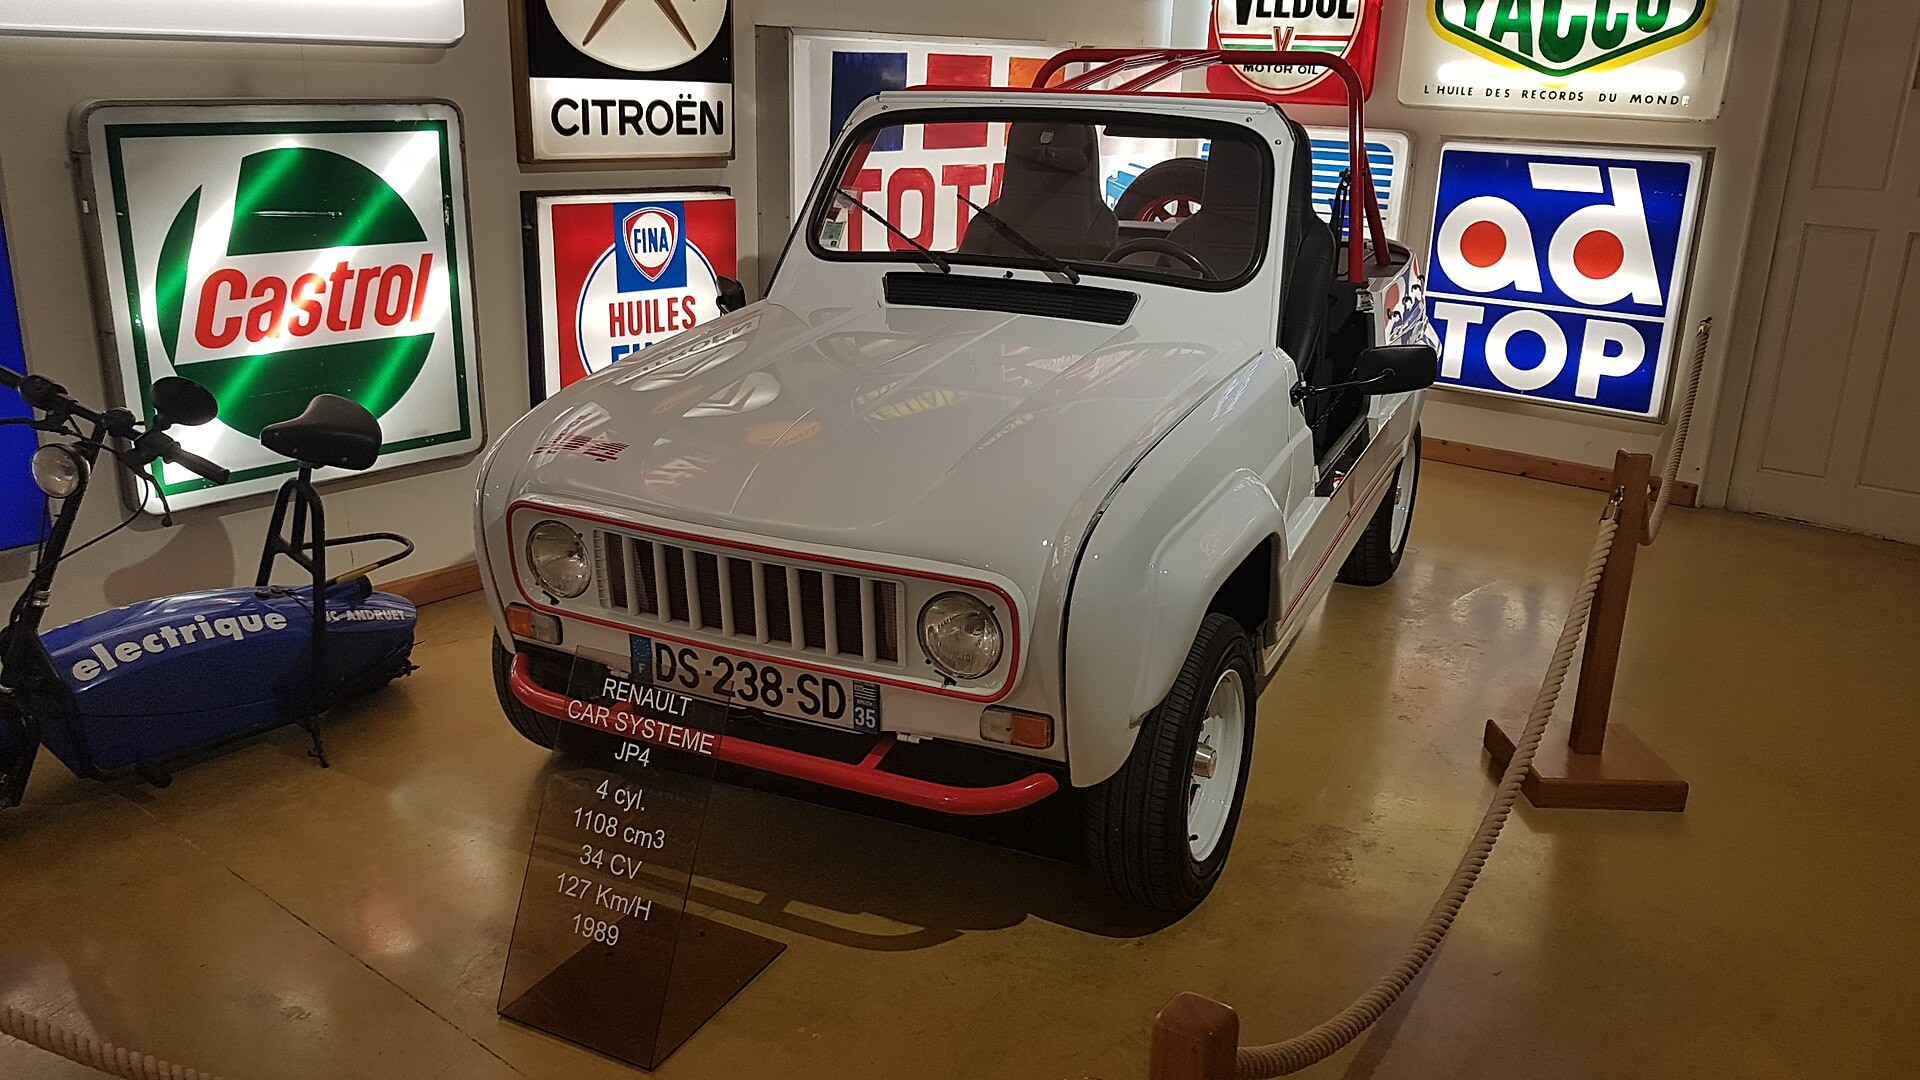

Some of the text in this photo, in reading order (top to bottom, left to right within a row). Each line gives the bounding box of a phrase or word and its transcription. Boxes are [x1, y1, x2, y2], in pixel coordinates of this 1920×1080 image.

[1243, 64, 1318, 75] MOTOR OIL
[550, 93, 724, 137] CITROËN
[1437, 85, 1474, 96] HUILE
[1485, 87, 1510, 98] DES
[1521, 89, 1584, 102] RECORDS
[1598, 93, 1617, 103] DU
[1629, 94, 1689, 107] MOND
[843, 163, 1005, 252] TOT
[633, 226, 669, 254] FINA
[194, 252, 434, 350] Castrol
[608, 295, 697, 338] HUILES
[1433, 301, 1646, 400] TOP
[71, 613, 289, 682] electrique
[602, 678, 692, 716] RENAULT
[654, 641, 847, 720] DS-238-SD
[568, 700, 715, 755] CAR SYSTEME
[854, 706, 877, 729] 35
[614, 742, 650, 767] JP4
[596, 779, 645, 812] 4 cyl.
[574, 807, 665, 849] 1108 cm3
[580, 844, 643, 880] 34 CV
[557, 872, 652, 921] 127 Km/H
[572, 913, 619, 946] 1989
